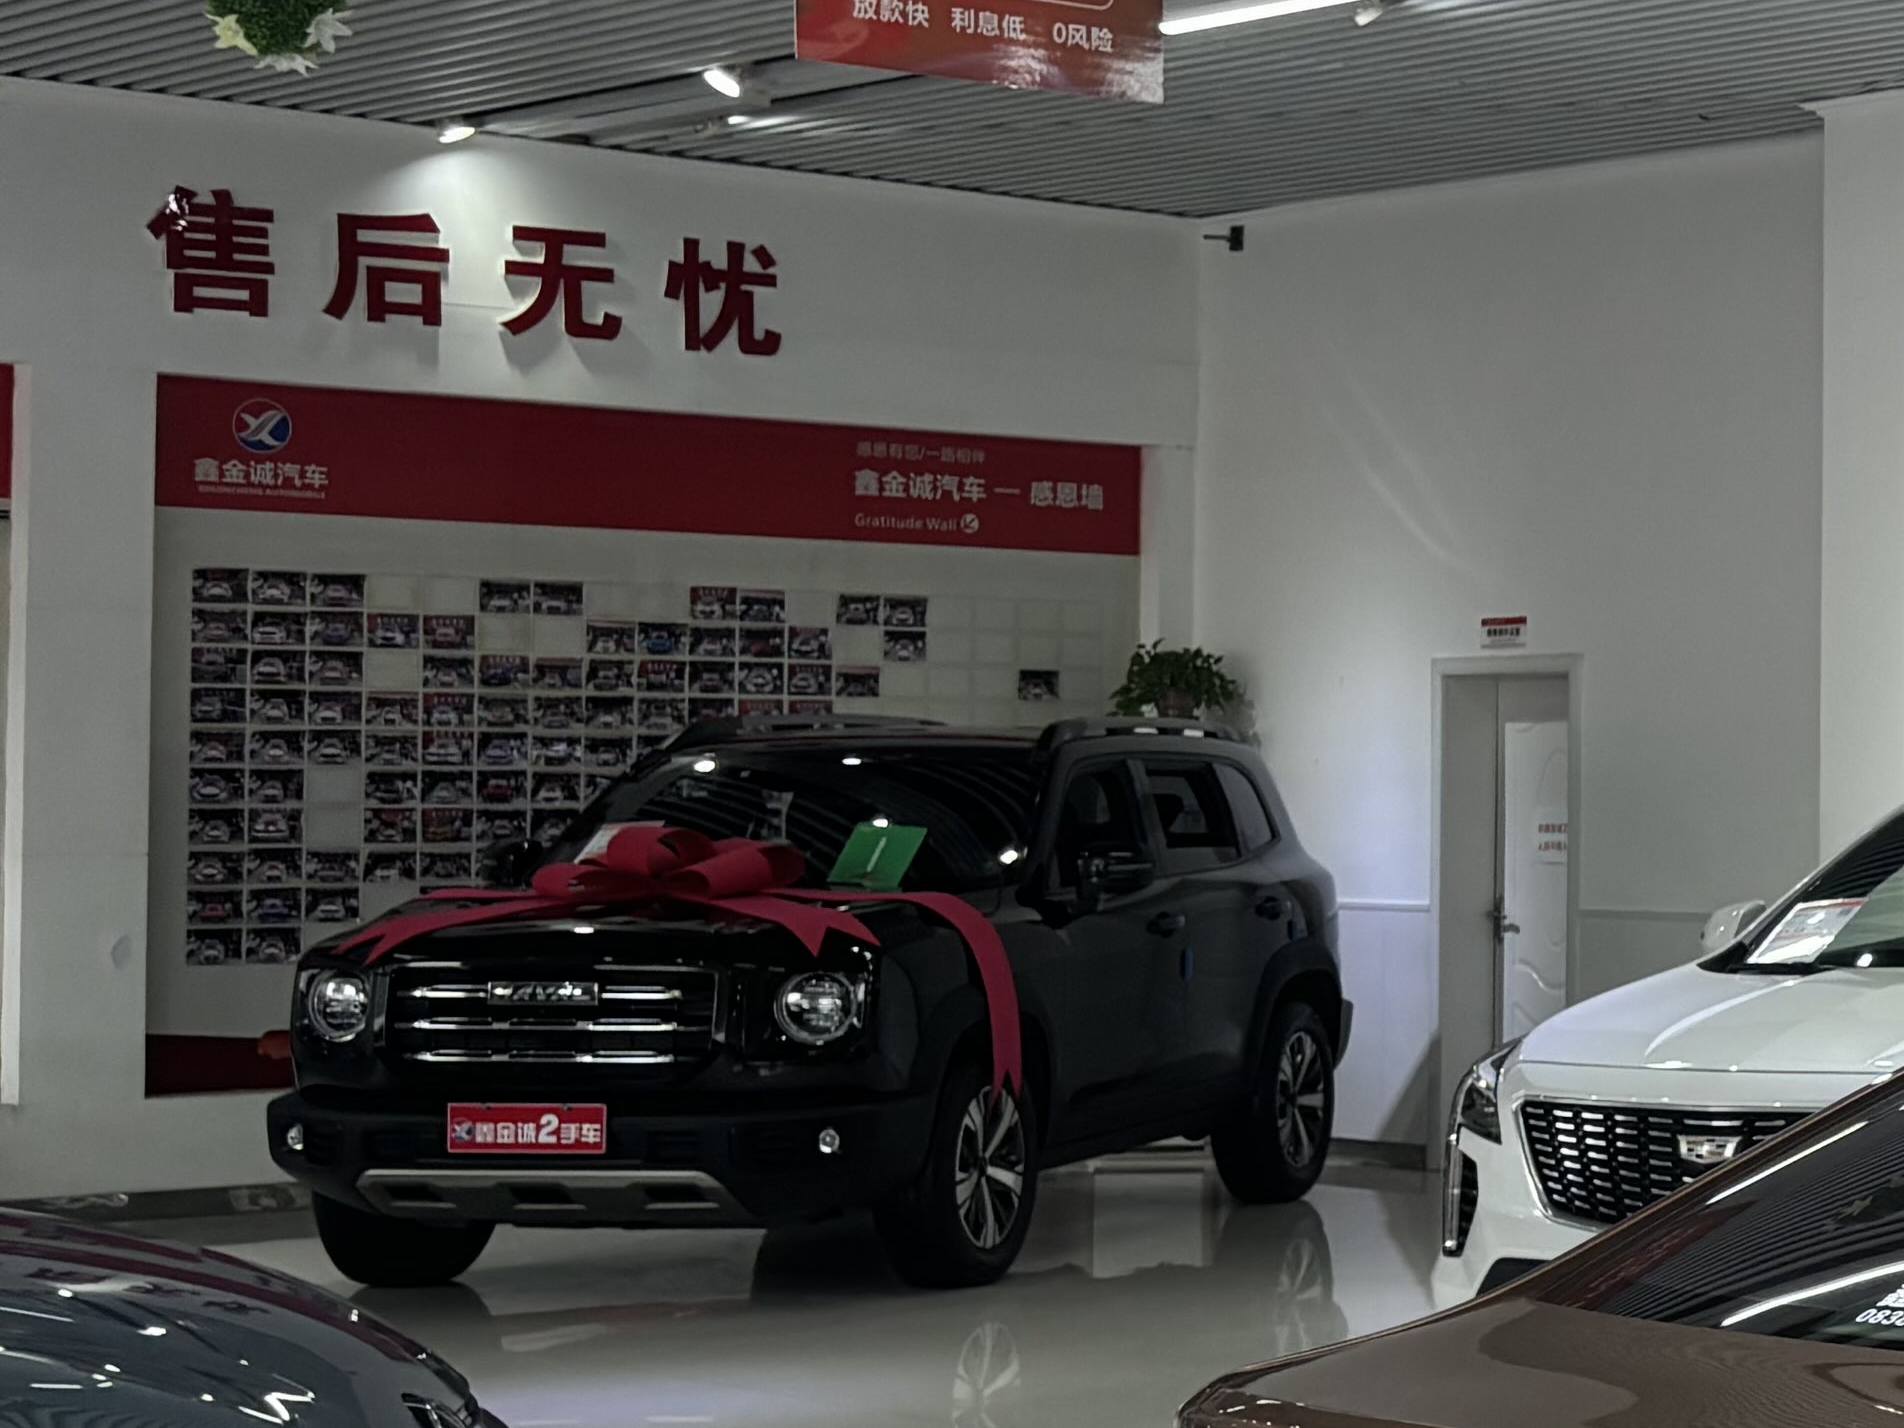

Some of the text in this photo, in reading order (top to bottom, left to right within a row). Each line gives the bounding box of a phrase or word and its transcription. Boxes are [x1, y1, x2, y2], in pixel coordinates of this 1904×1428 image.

[951, 7, 1025, 40] 利息低
[1053, 24, 1113, 53] 0风险
[146, 184, 783, 356] 售后无忧
[194, 457, 329, 489] 鑫金诚汽车
[854, 468, 987, 503] 鑫金诚汽车
[1029, 480, 1105, 511] 感恩墙
[854, 512, 958, 532] Gratitude Wall
[475, 1113, 602, 1146] 鑫金诚2手车
